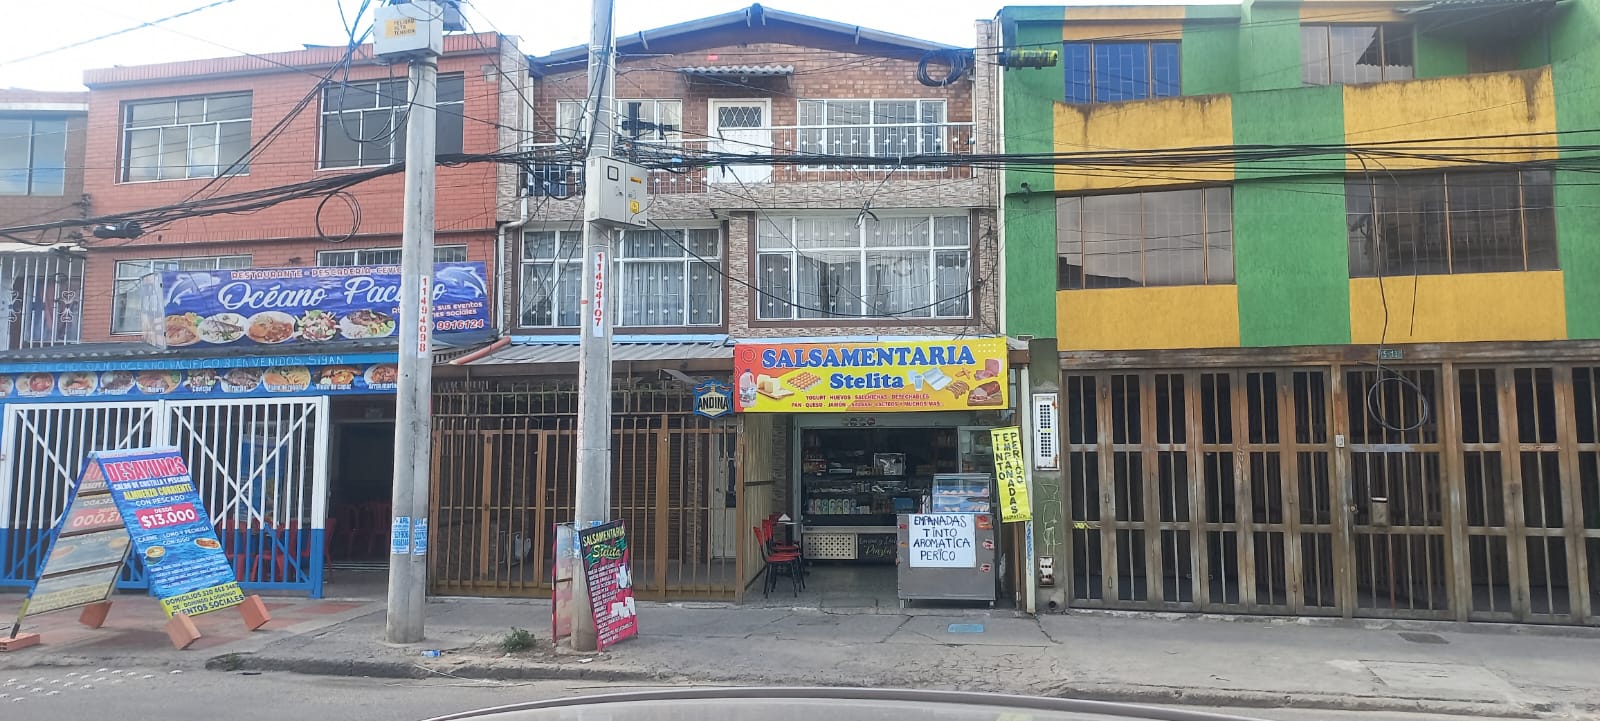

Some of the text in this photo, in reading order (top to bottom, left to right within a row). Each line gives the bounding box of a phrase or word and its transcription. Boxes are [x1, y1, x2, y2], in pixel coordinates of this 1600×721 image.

[231, 269, 301, 280] RESTAURANTE
[218, 281, 327, 310] Océano
[594, 253, 603, 327] 11494107
[762, 345, 976, 368] SALSAMENTARIA
[830, 372, 904, 390] Stelita
[698, 396, 729, 410] ANDINA
[993, 433, 1006, 481] TINTO
[1010, 432, 1024, 484] PERICO
[103, 456, 187, 482] DESAYUNOS
[1002, 433, 1018, 514] EMPANADAS
[140, 478, 163, 488] COSTILLA
[167, 475, 191, 485] PESCADO
[123, 483, 193, 500] ALMUERZO CORRIENTE
[152, 495, 185, 504] PESCADO
[141, 509, 195, 528] $13.000
[154, 506, 173, 514] DESDE
[913, 515, 966, 528] EMPANADAS
[582, 527, 625, 546] SALSAMENTARIA
[922, 527, 957, 537] TINTO
[913, 537, 970, 548] AROMATICA
[920, 548, 956, 561] PERICO
[209, 595, 244, 608] SOCIALES
